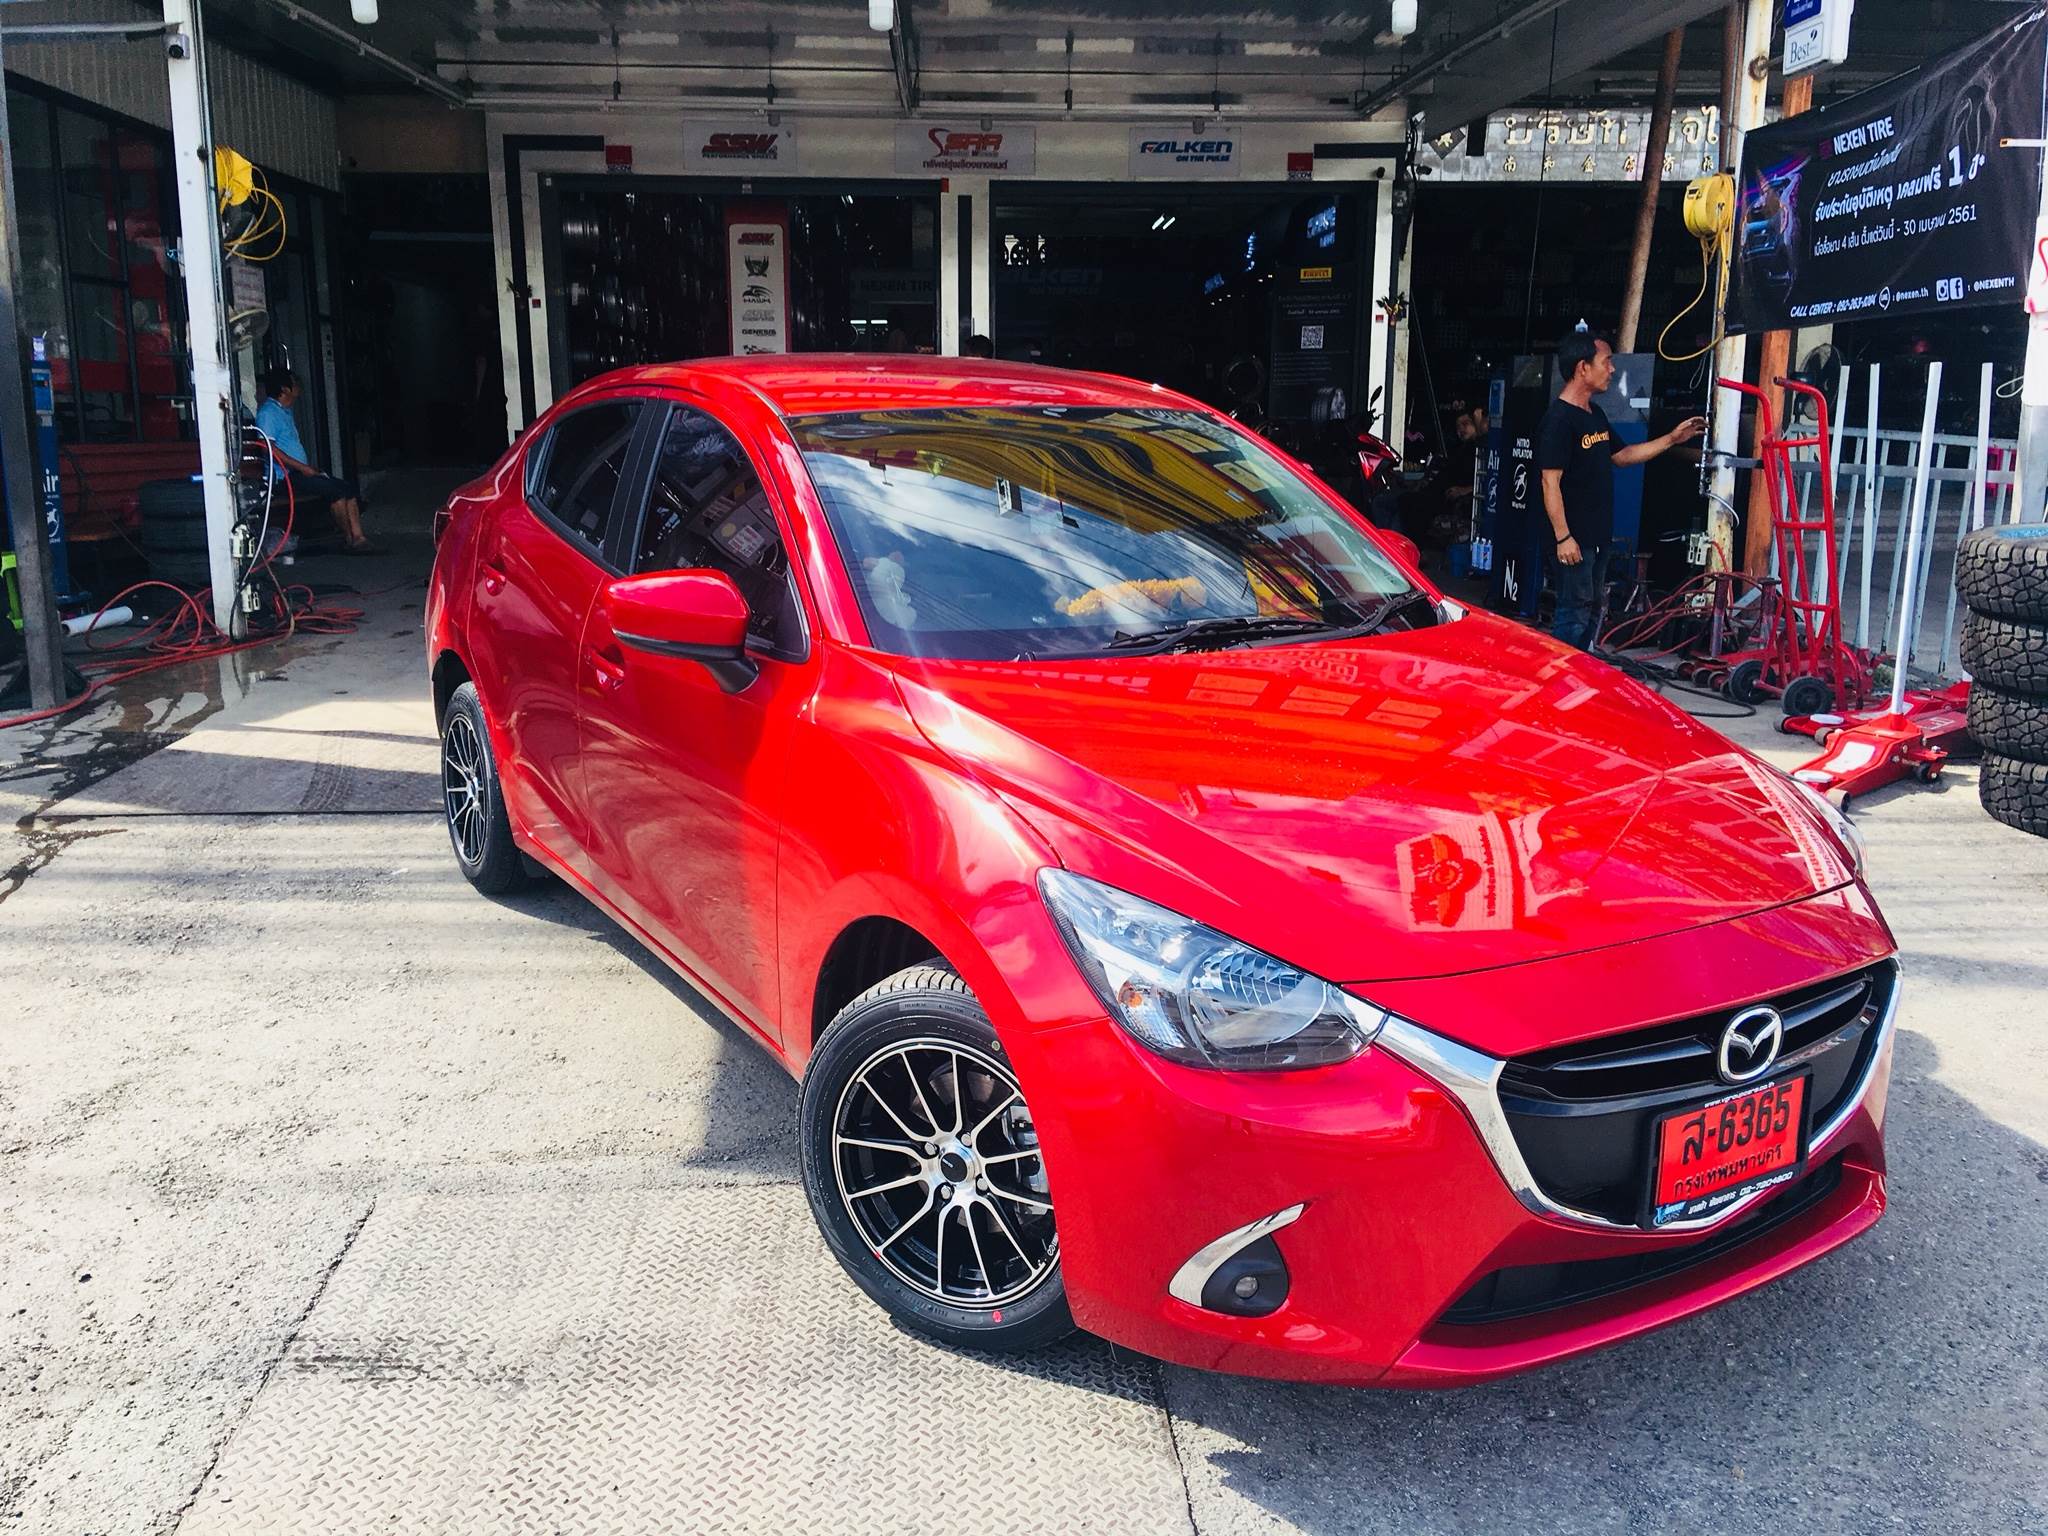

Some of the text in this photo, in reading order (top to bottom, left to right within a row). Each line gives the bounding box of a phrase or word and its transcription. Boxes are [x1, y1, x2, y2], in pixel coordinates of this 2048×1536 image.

[1790, 42, 1810, 63] Best
[701, 133, 778, 153] SSW
[1833, 116, 1894, 155] NEXEN TIRE
[1140, 141, 1233, 154] FALKEN
[1176, 154, 1230, 162] ON THE PULSE
[1948, 144, 1964, 188] 1
[1841, 235, 1848, 249] 4
[1903, 219, 1917, 236] 30
[1947, 203, 1977, 225] 2561
[1973, 276, 2015, 293] @NEXENTH
[1790, 305, 1808, 318] CALL
[741, 328, 777, 337] GENESIS
[1516, 437, 1531, 449] NITRO
[1512, 447, 1534, 460] INFLATOR
[42, 468, 59, 493] ir
[1673, 1144, 1784, 1199] กรุงเทพมหานคร
